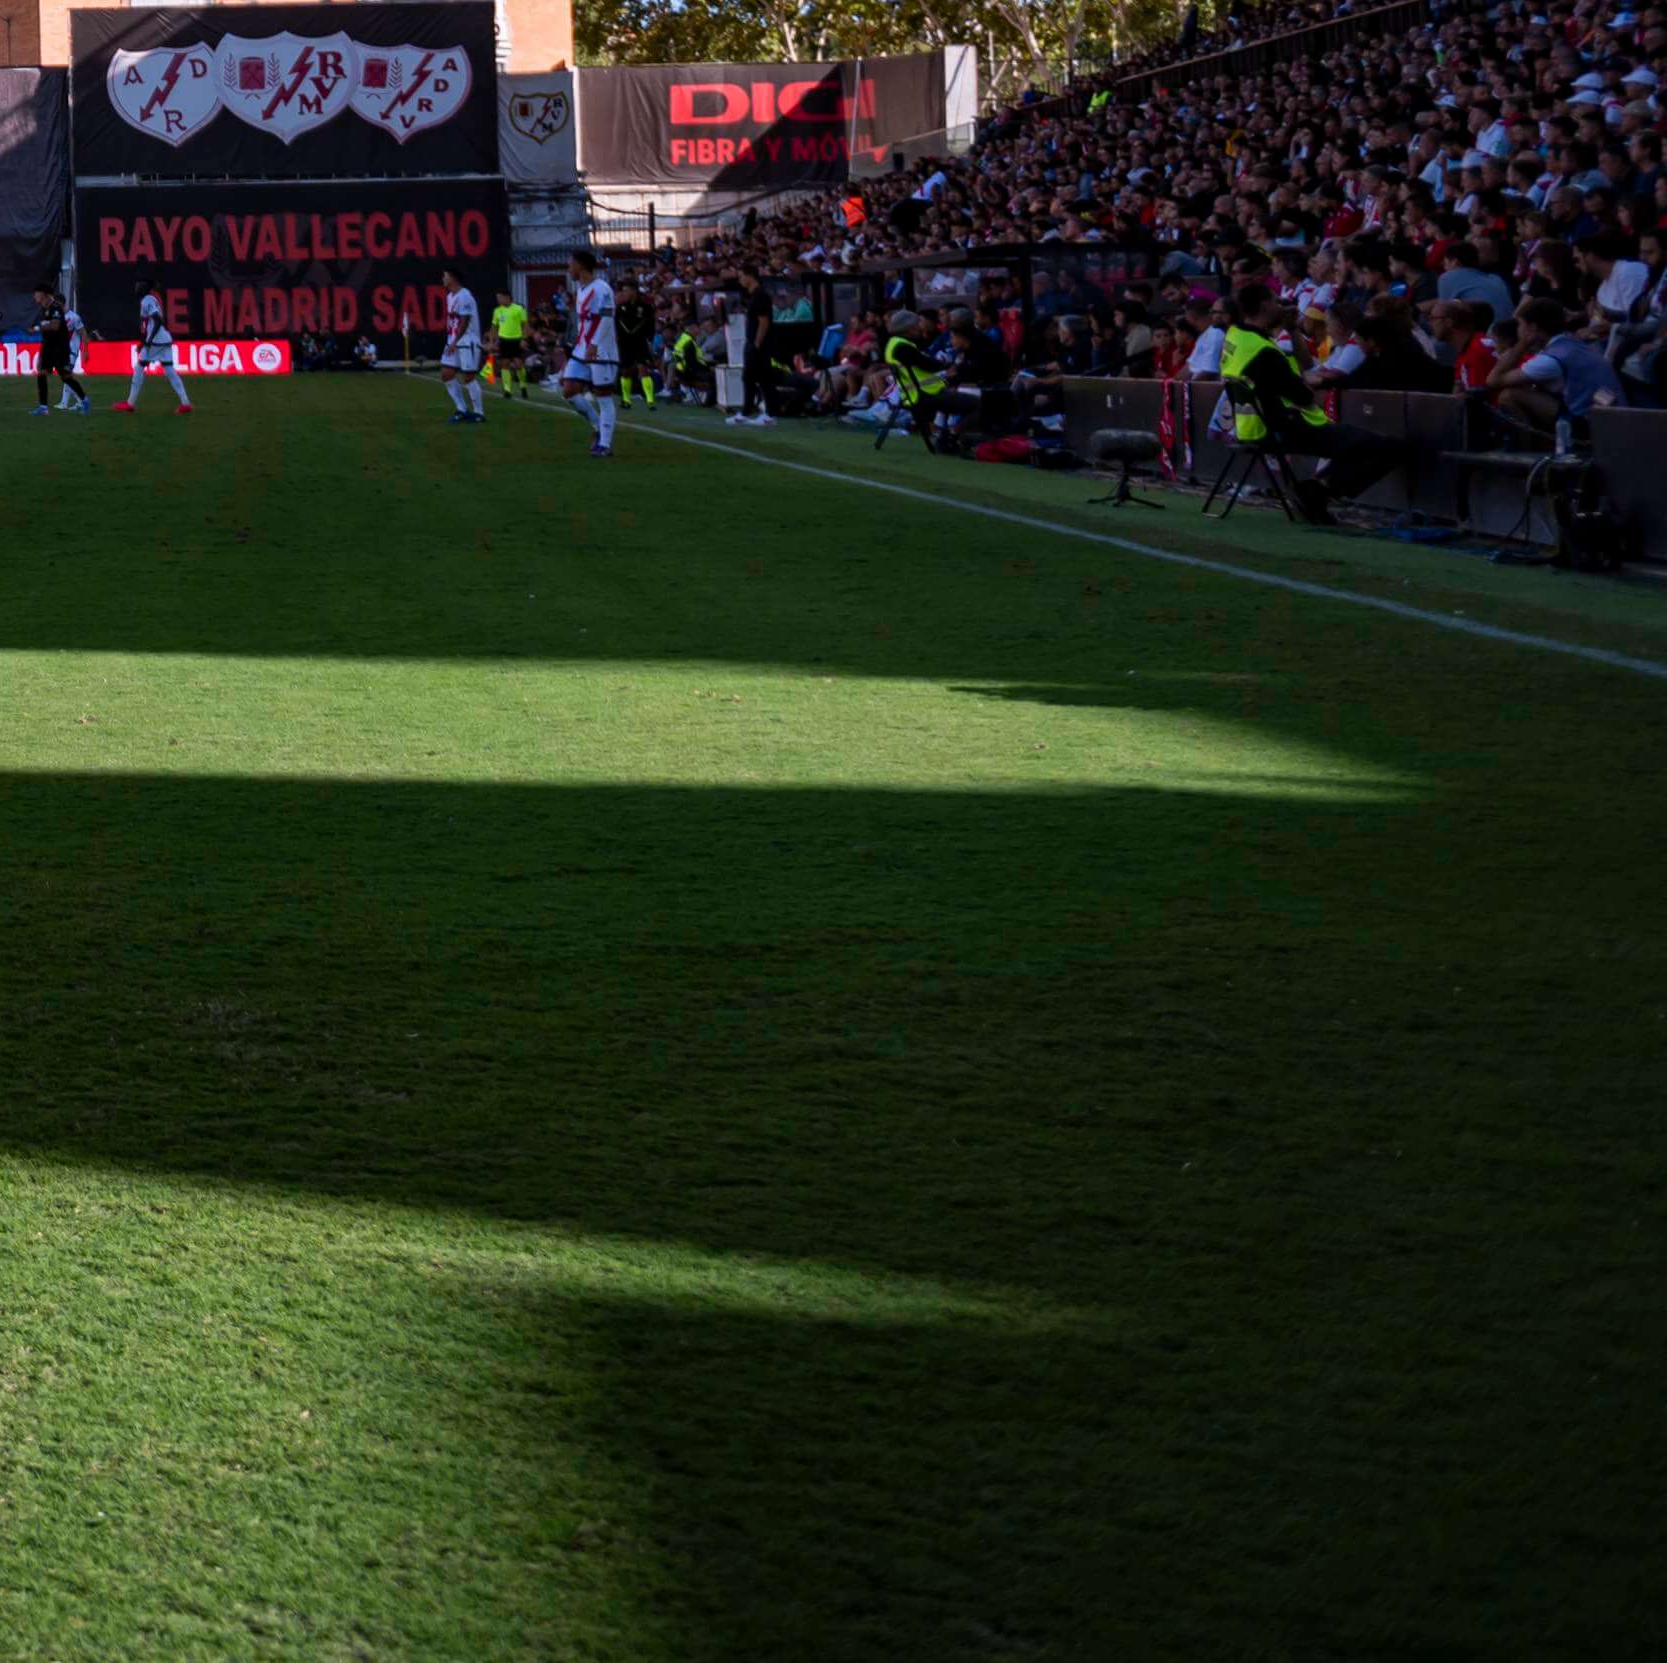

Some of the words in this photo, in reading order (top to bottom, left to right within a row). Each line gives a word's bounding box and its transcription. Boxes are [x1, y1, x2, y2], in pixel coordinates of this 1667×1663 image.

[123, 65, 144, 86] A
[190, 58, 207, 79] D
[317, 51, 347, 78] R
[442, 57, 458, 72] A
[310, 76, 340, 100] V
[434, 78, 449, 93] D
[298, 95, 324, 115] M
[417, 98, 434, 112] R
[165, 109, 187, 132] R
[400, 115, 416, 129] V
[670, 137, 755, 166] FIBRA
[765, 135, 781, 163] Y
[100, 215, 212, 263] RAYO
[226, 210, 489, 261] VALLECANO
[204, 287, 357, 334] MADRID
[131, 344, 242, 371] LLIGA
